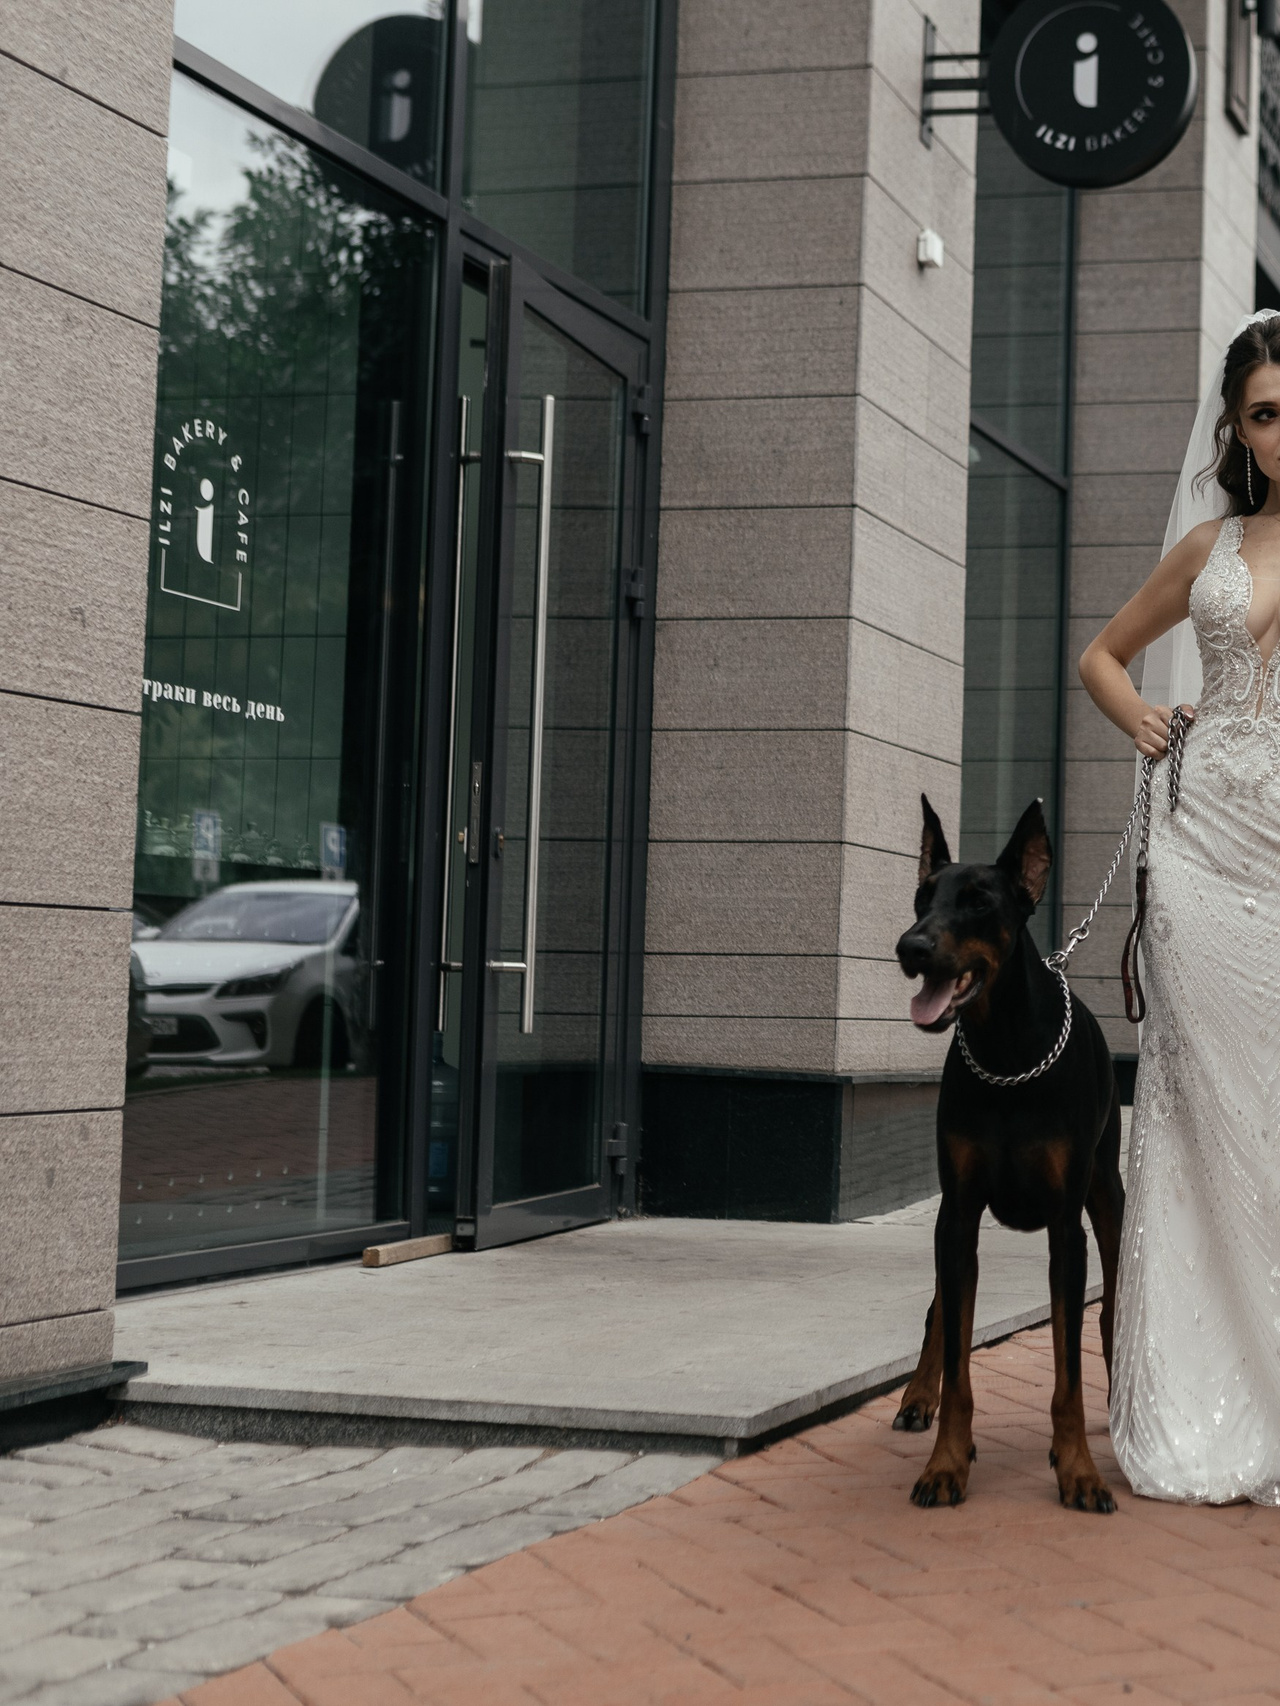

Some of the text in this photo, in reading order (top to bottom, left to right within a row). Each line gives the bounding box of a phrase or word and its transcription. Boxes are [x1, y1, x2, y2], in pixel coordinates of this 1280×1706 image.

[1035, 12, 1164, 152] ILZI BAKERY & CAFE
[1073, 32, 1099, 108] i
[158, 418, 250, 564] ILZI BAKERY & CAFE
[194, 478, 215, 564] i
[202, 690, 242, 714] весь
[245, 699, 285, 722] день
